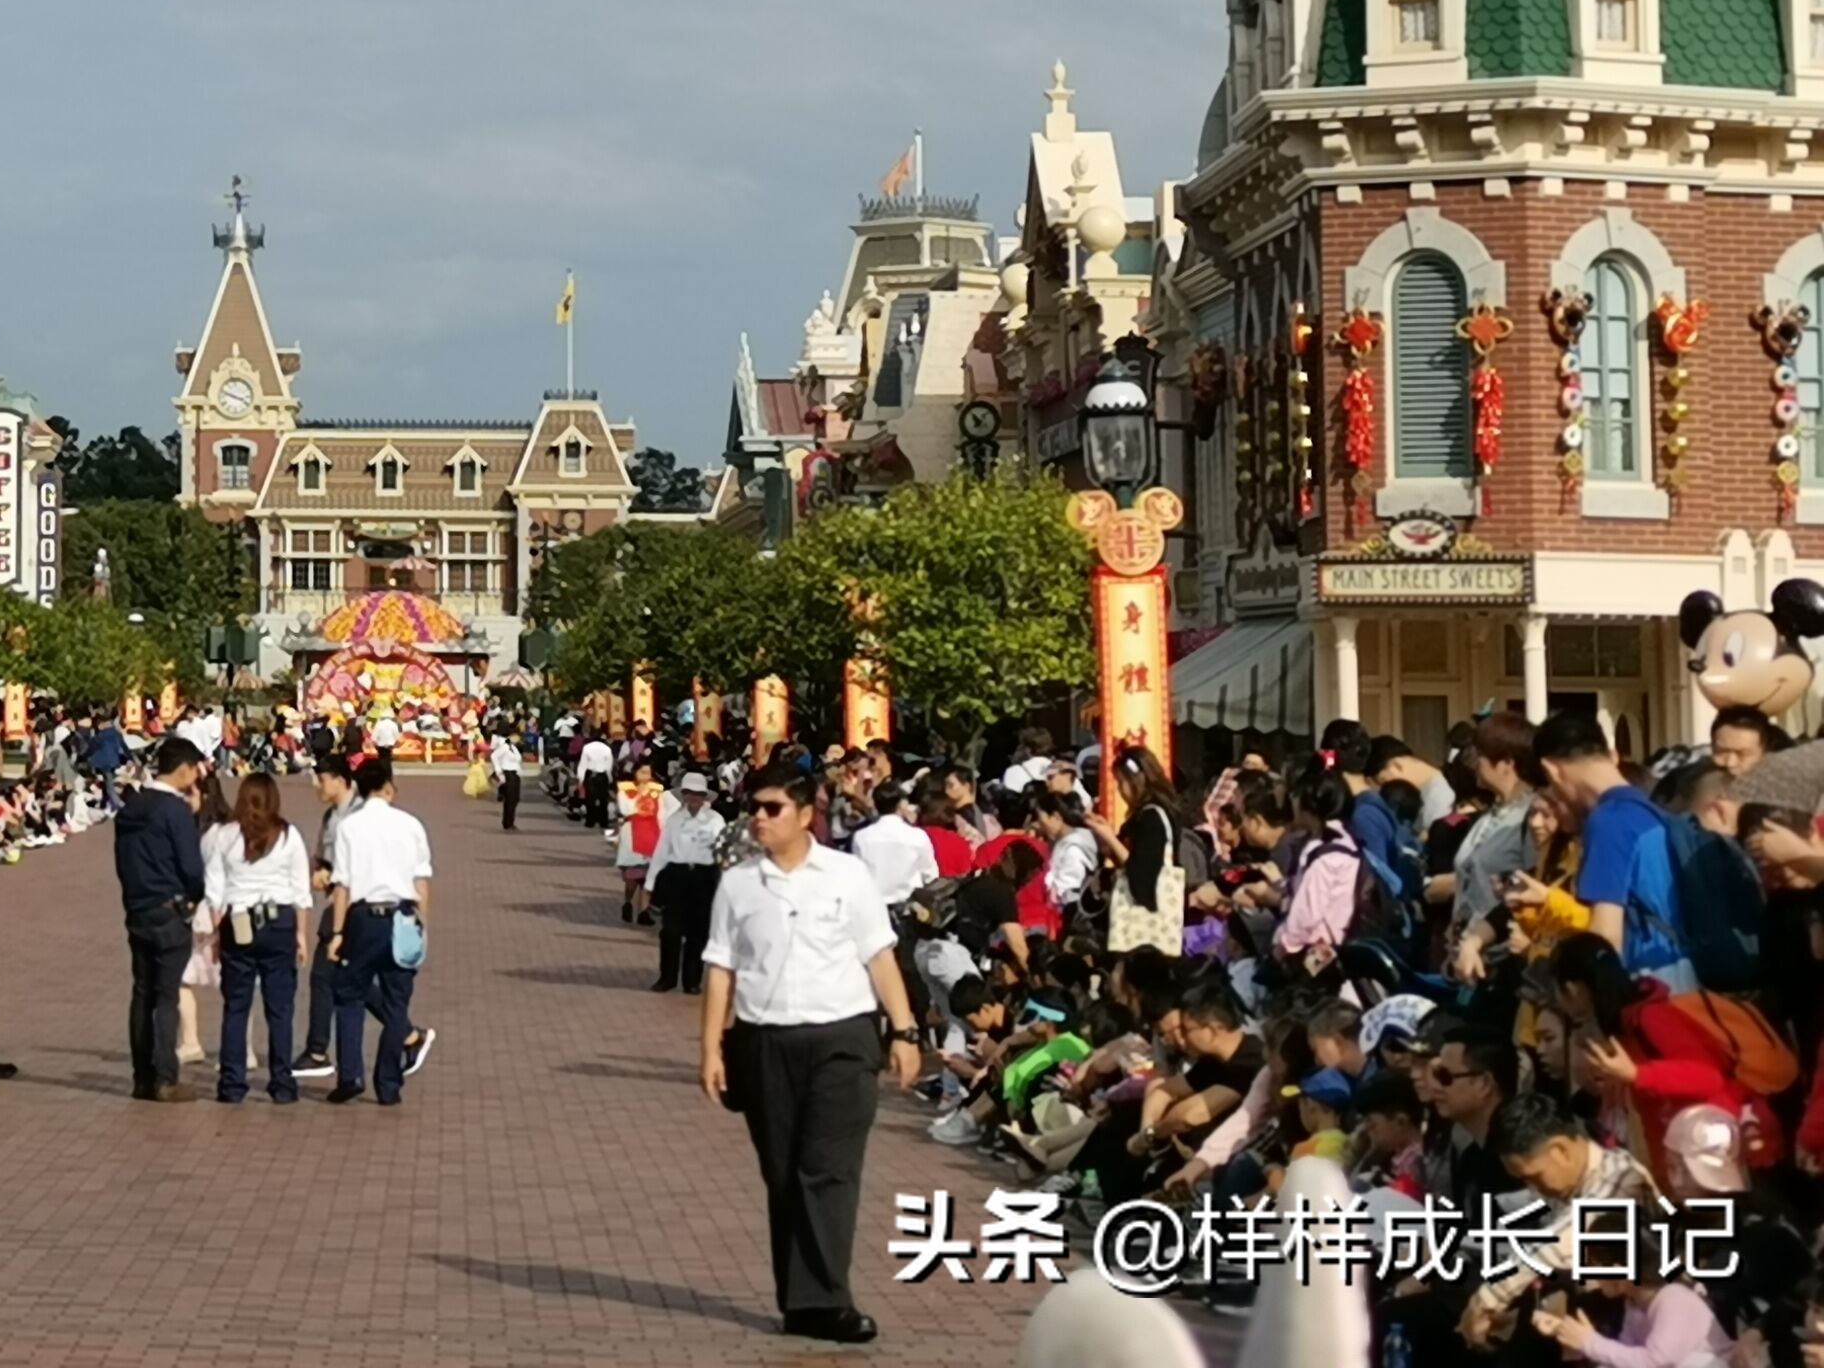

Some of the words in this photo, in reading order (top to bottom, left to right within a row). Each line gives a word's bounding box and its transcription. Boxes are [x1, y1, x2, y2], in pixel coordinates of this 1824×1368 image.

[1332, 570, 1375, 590] MAIN
[1381, 569, 1441, 590] STREET
[1449, 567, 1517, 590] SWEETS
